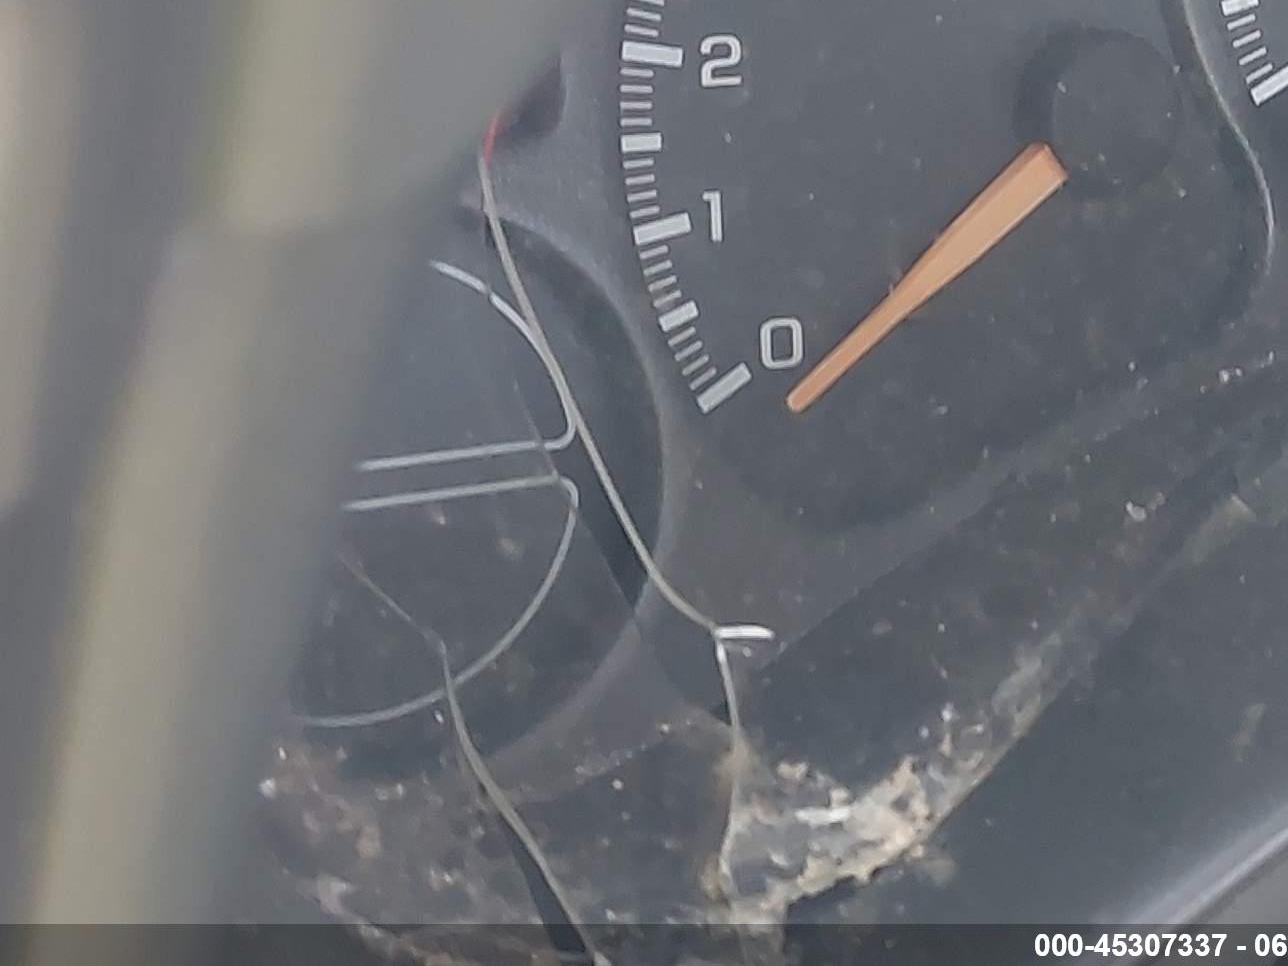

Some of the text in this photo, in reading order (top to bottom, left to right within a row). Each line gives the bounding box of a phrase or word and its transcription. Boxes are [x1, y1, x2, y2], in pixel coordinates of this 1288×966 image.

[700, 35, 743, 88] 2
[703, 190, 723, 242] 1
[760, 317, 803, 369] 0
